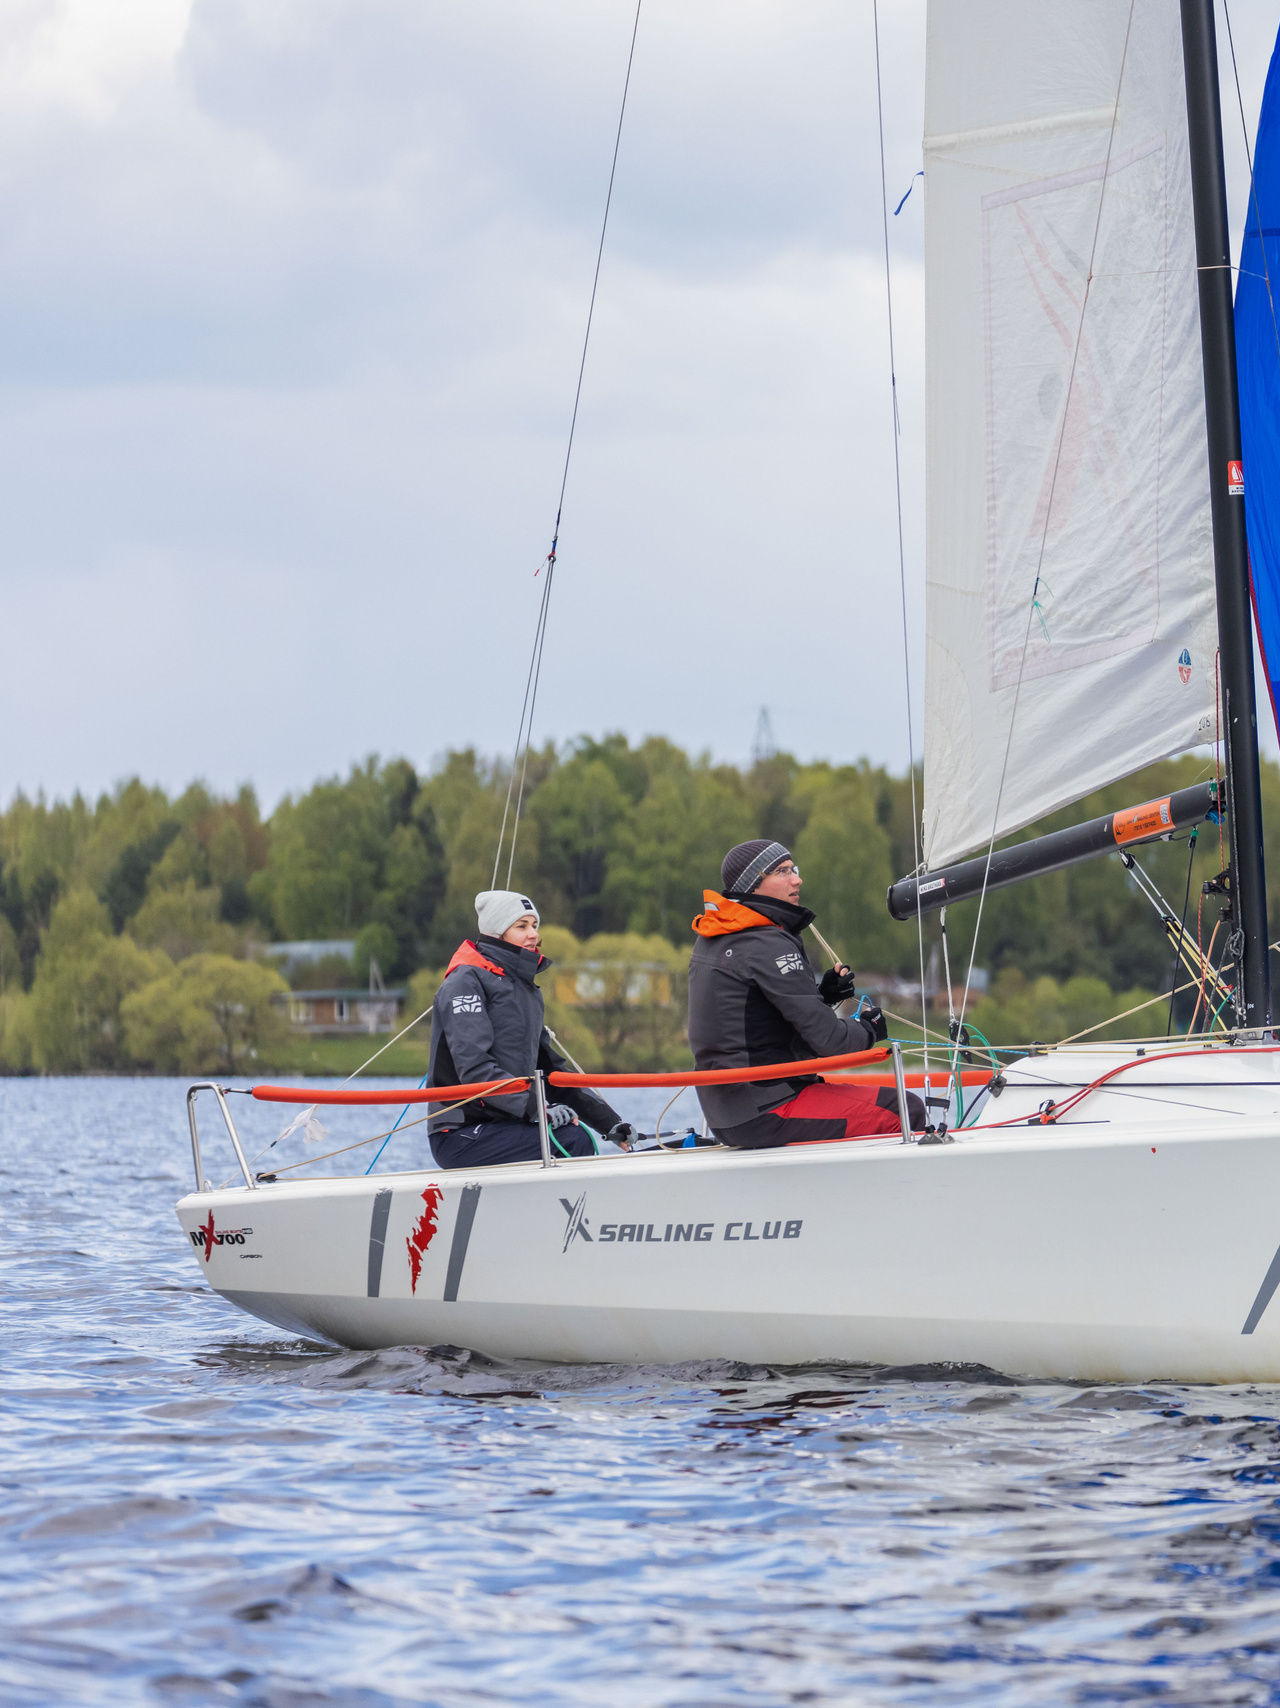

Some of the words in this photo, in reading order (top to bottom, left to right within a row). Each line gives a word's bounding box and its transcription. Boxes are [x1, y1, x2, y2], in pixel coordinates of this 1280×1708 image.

[1198, 714, 1210, 731] 106
[598, 1223, 715, 1243] SAILING
[723, 1219, 804, 1242] CLUB
